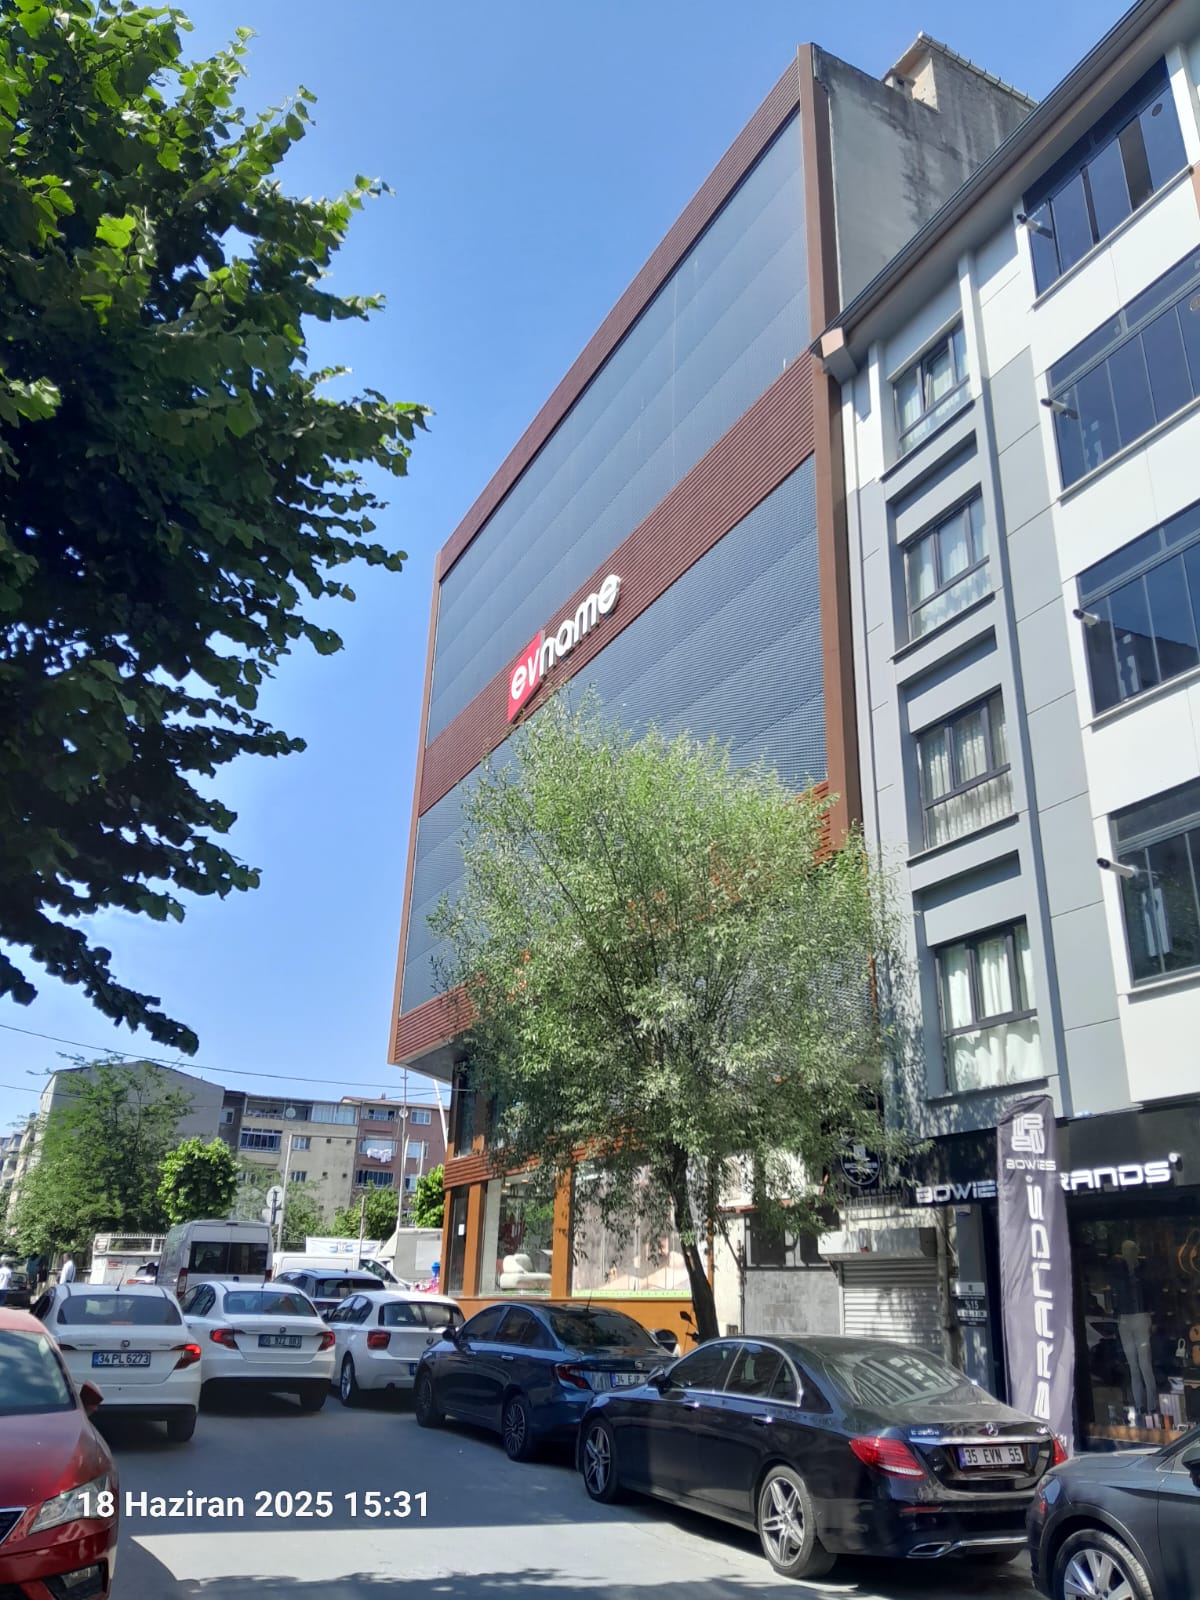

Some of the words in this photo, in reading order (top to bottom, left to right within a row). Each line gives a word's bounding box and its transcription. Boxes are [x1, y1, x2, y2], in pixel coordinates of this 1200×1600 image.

[916, 1180, 999, 1204] BOWIE
[1026, 1185, 1055, 1420] BRANDS
[98, 1353, 110, 1364] 34
[112, 1353, 125, 1364] PL
[126, 1353, 149, 1364] 6273
[965, 1448, 978, 1464] 35
[984, 1448, 1003, 1464] EVN
[1009, 1447, 1023, 1463] 55
